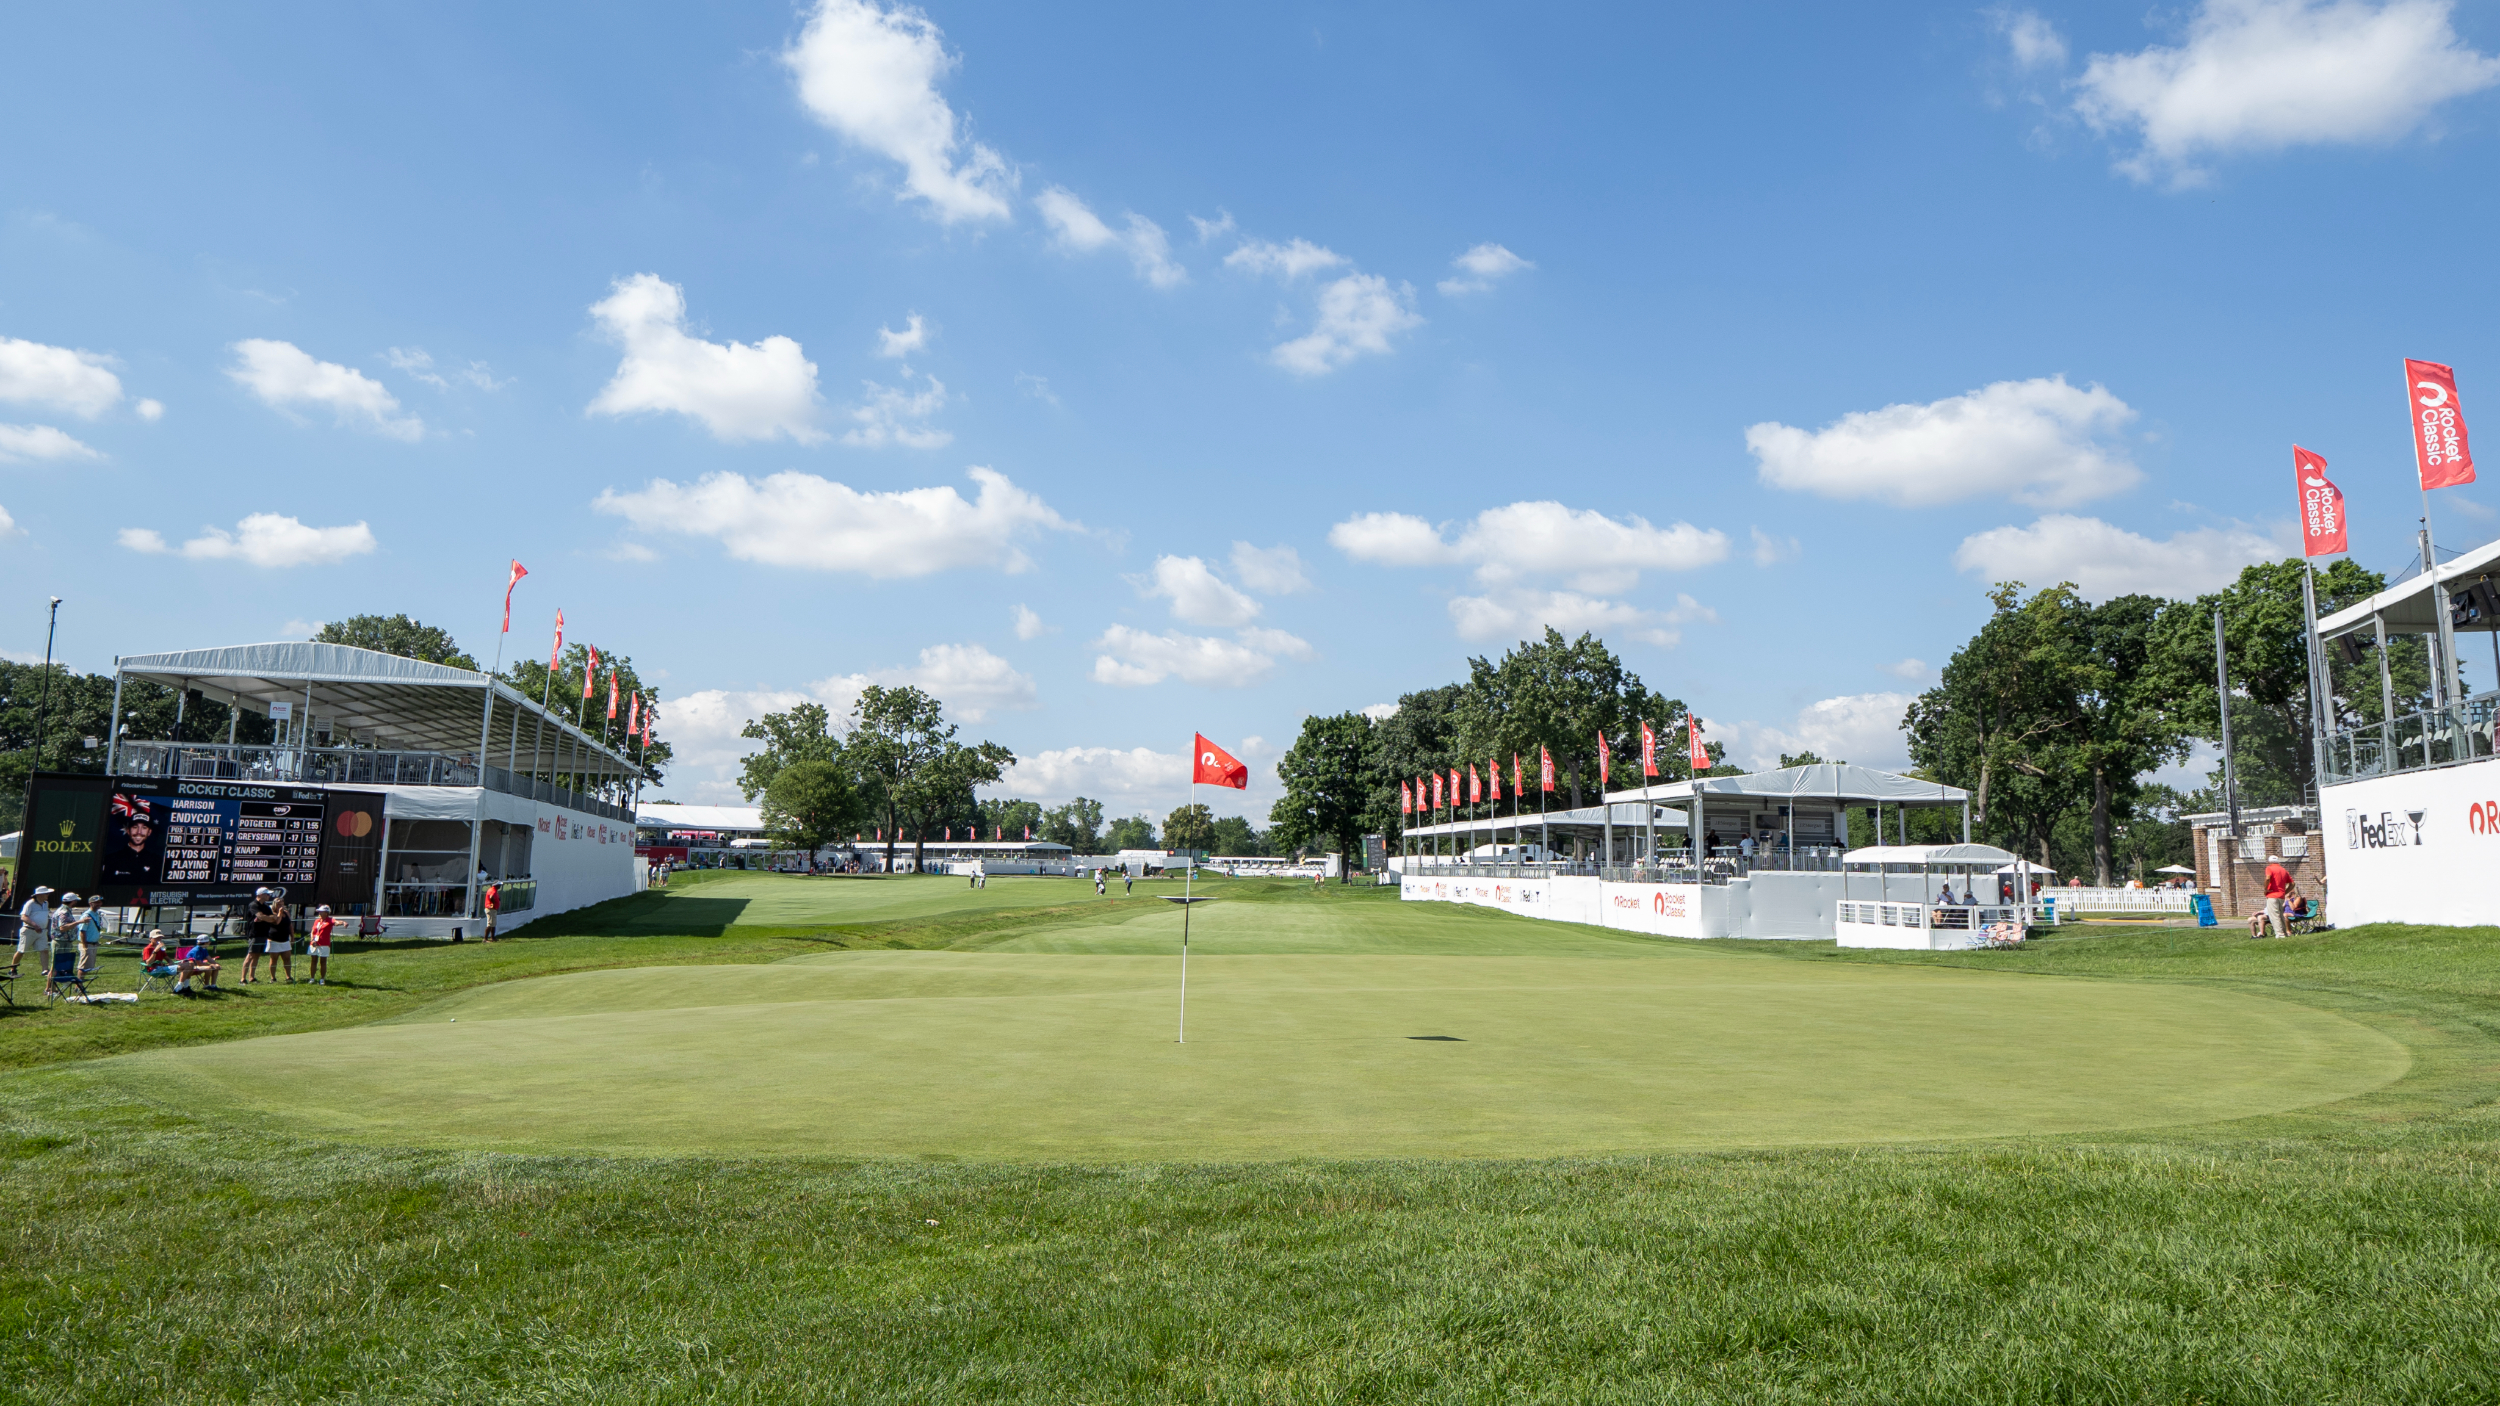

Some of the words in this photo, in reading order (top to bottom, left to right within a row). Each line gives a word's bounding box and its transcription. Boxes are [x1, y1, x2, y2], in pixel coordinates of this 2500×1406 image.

[2422, 410, 2442, 466] Classic
[2438, 408, 2462, 463] Rocket
[2306, 489, 2324, 536] Classic
[2320, 488, 2338, 535] Rocket
[178, 783, 226, 796] ROCKET
[228, 787, 276, 798] CLASSIC
[172, 799, 215, 810] HARRISON
[170, 812, 221, 824] ENDYCOTT
[240, 820, 277, 828] POTGIETER
[2360, 812, 2407, 848] FedEx
[190, 836, 198, 844] -5
[238, 832, 281, 841] GREYSERMN
[35, 840, 93, 852] ROLEX
[235, 846, 260, 854] KNAPP
[166, 850, 180, 858] 147
[181, 850, 199, 859] YDS
[200, 850, 218, 859] OUT
[172, 860, 209, 869] PLAYING
[167, 871, 185, 880] 2ND
[187, 871, 210, 880] SHOT
[1620, 896, 1640, 909] Rocket
[1665, 892, 1686, 904] Rocket
[1665, 905, 1686, 917] Classic
